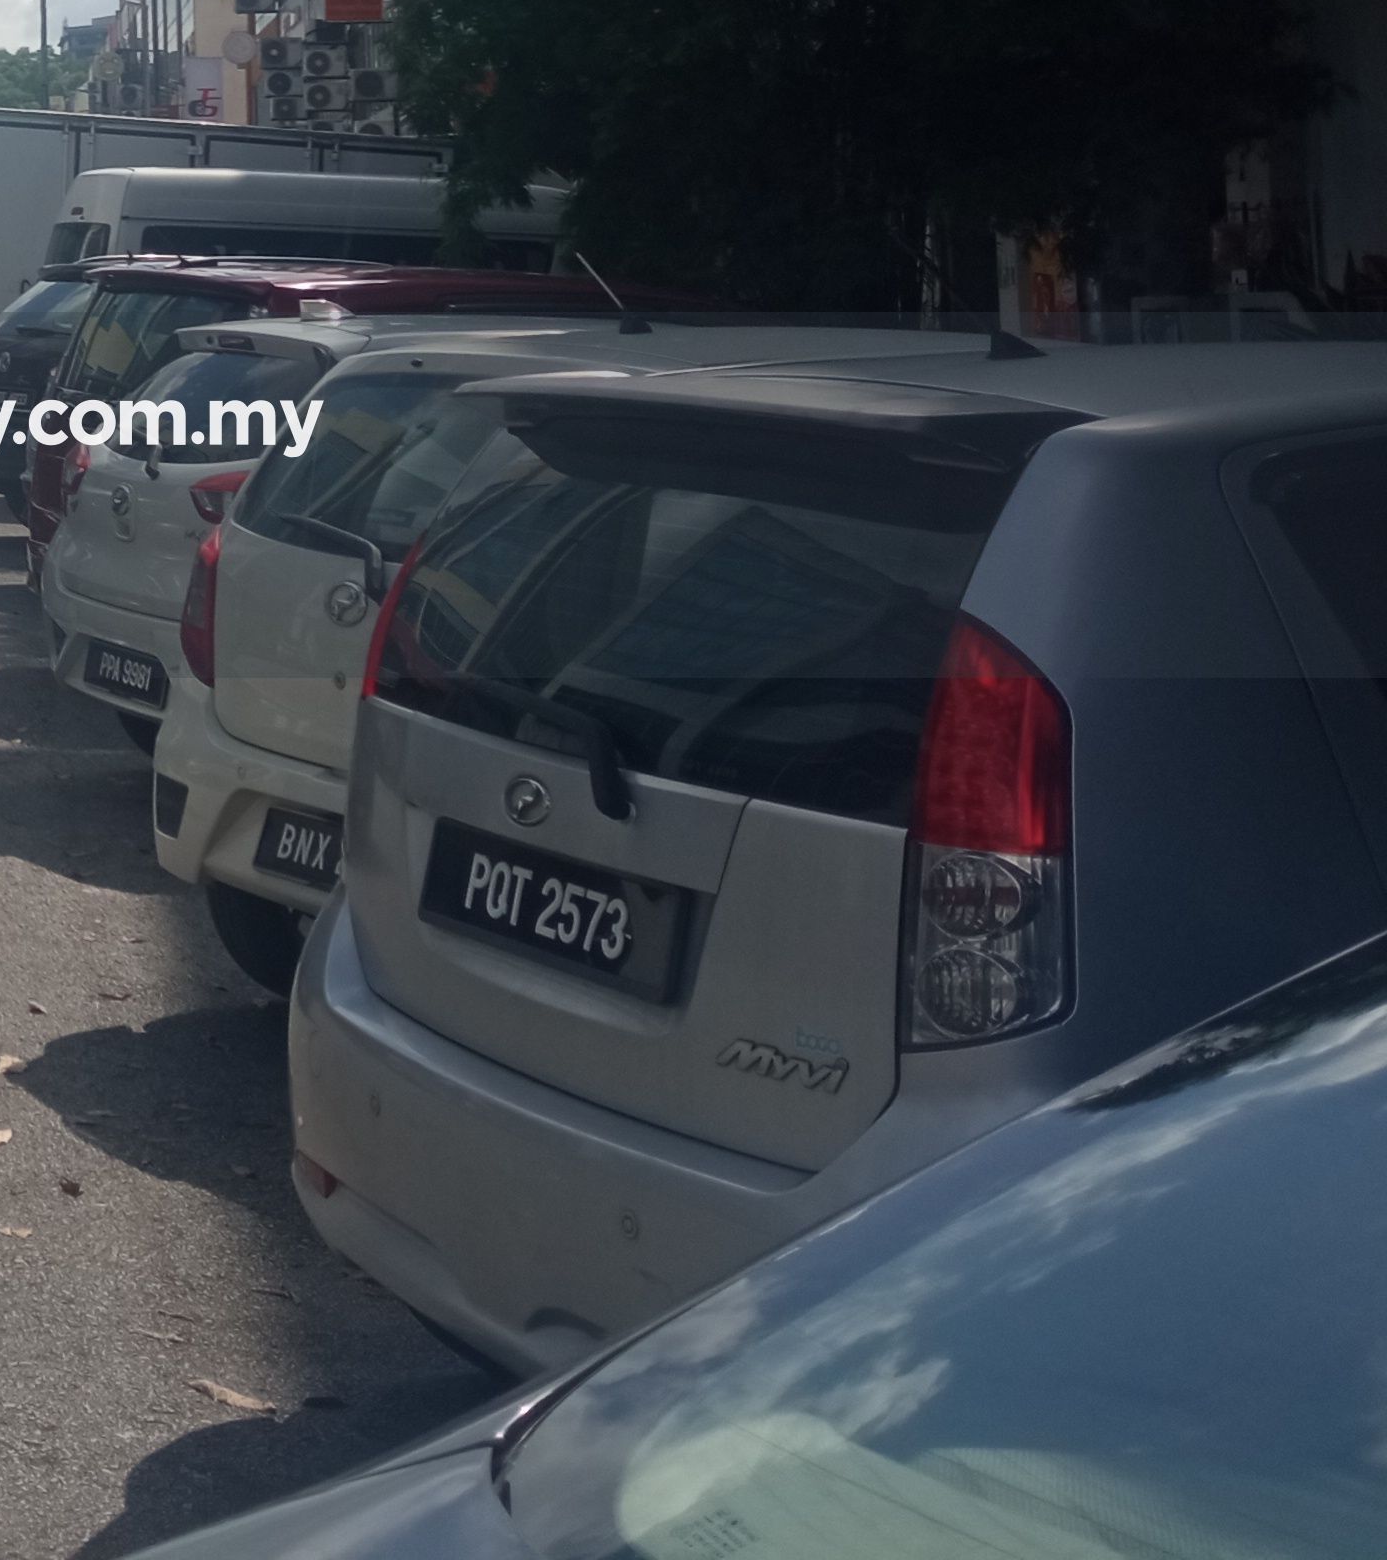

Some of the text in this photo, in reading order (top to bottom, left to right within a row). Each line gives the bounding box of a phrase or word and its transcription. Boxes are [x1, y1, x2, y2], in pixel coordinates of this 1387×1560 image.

[99, 652, 121, 682] PPA
[276, 822, 332, 870] BNX
[464, 851, 630, 960] PQT 2573
